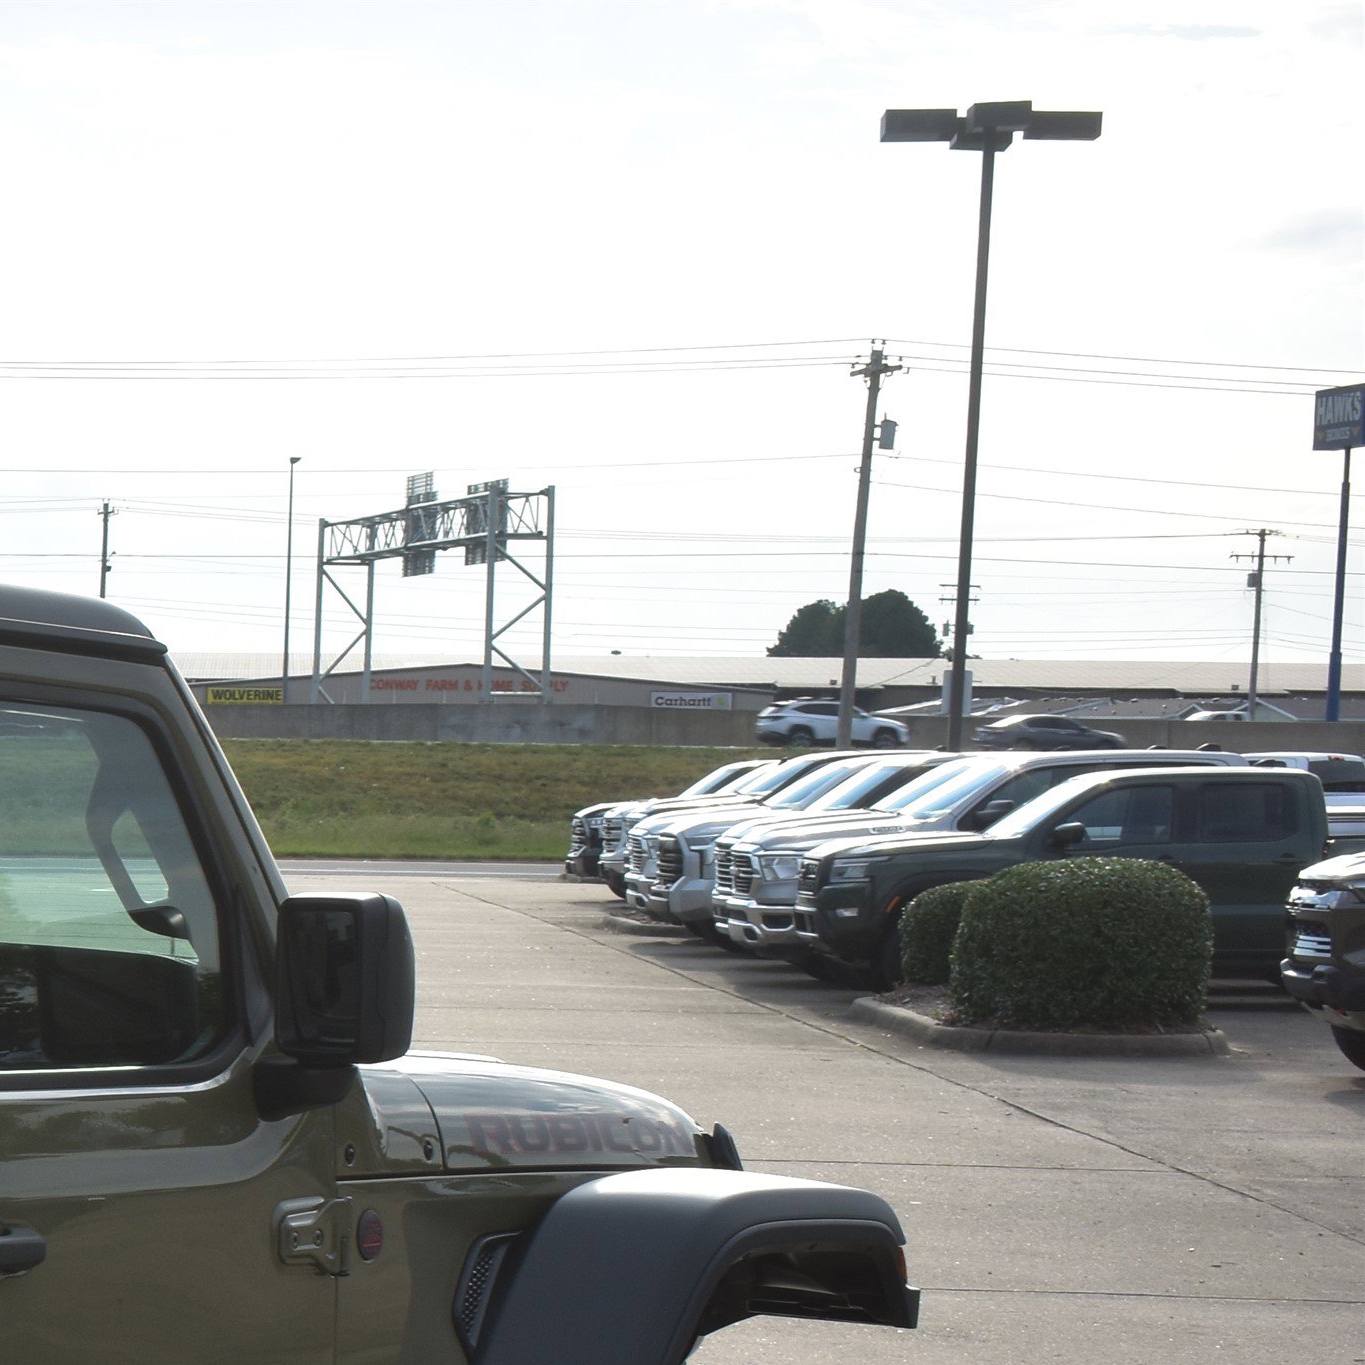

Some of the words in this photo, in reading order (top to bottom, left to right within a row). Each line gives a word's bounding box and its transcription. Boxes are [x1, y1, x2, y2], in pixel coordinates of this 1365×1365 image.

[1316, 391, 1362, 426] HAWKS
[370, 679, 418, 691] CONWAY
[425, 679, 459, 691] FARM
[464, 679, 473, 691] &
[211, 688, 283, 701] WOLVERINE
[654, 695, 712, 707] Carhartt
[464, 1113, 697, 1157] RUBICON
